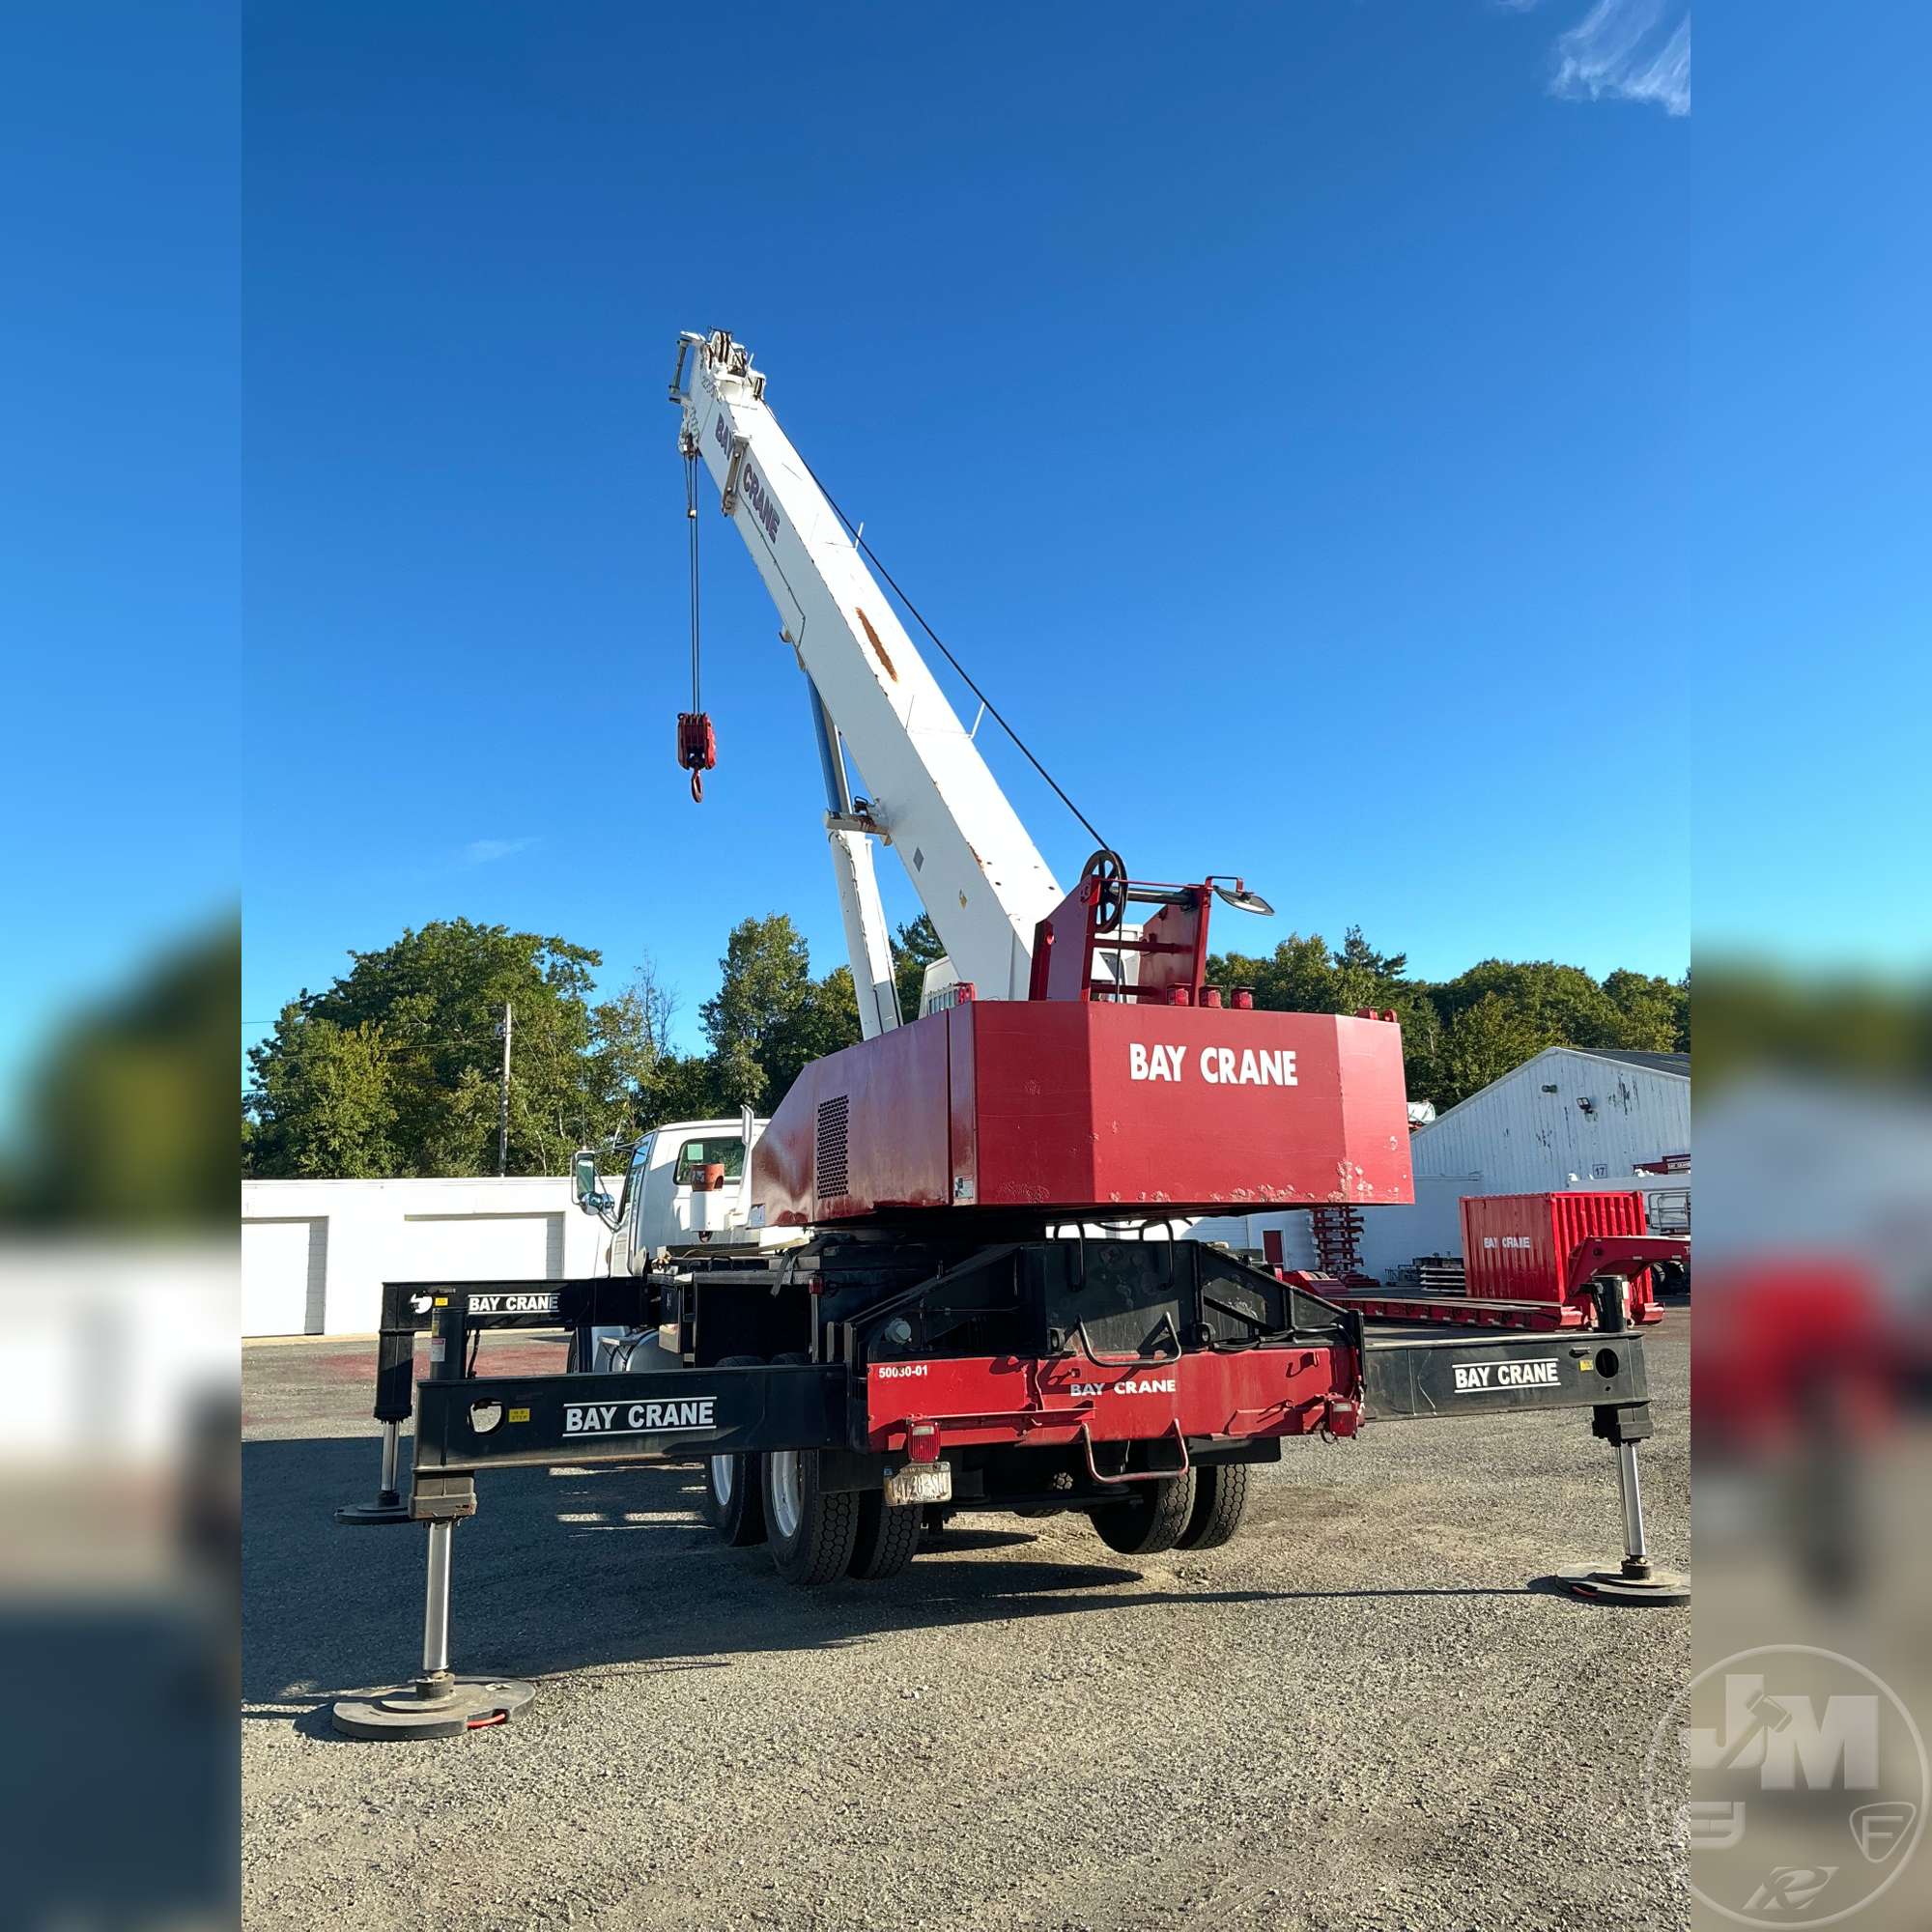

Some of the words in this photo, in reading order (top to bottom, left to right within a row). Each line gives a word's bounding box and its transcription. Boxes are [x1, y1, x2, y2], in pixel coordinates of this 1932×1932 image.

[743, 464, 780, 544] CRANE
[1129, 1043, 1186, 1082] BAY
[1200, 1047, 1298, 1086] CRANE
[1595, 1167, 1605, 1177] 17
[469, 1297, 500, 1312] BAY
[505, 1296, 558, 1311] CRANE
[879, 1365, 927, 1378] 50030-01
[1454, 1367, 1490, 1388] BAY
[1497, 1362, 1559, 1385] CRANE
[1070, 1383, 1105, 1397] BAY
[1113, 1379, 1176, 1394] CRANE
[566, 1406, 618, 1432] BAY
[628, 1402, 714, 1428] CRANE
